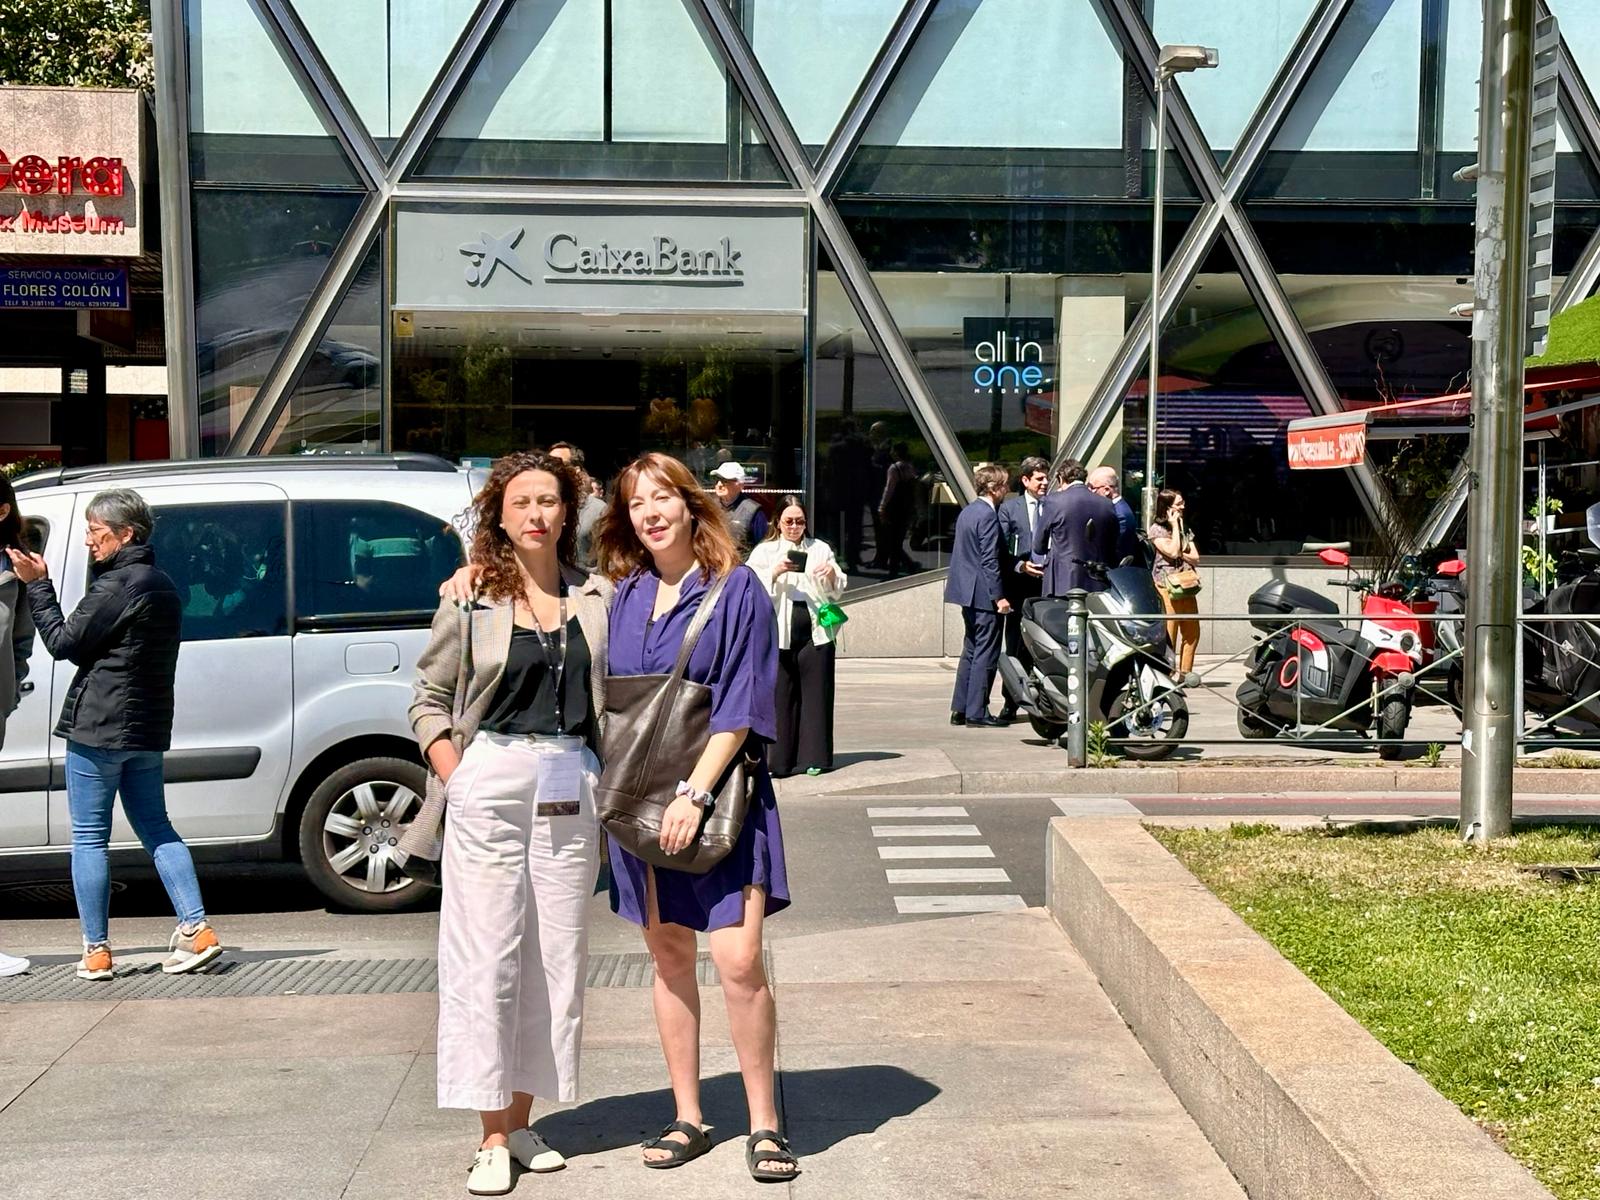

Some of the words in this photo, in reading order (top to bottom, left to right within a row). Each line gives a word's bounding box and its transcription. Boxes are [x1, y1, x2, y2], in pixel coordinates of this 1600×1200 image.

[0, 148, 123, 196] era
[21, 210, 124, 235] Museum
[543, 231, 744, 275] CaixaBank
[8, 270, 52, 280] SERVICIO
[54, 271, 62, 280] A
[63, 271, 115, 281] DOMICILIO
[3, 284, 57, 297] FLORES
[62, 282, 111, 298] COLÓN
[974, 330, 1006, 363] all
[1015, 336, 1043, 363] in
[974, 365, 1043, 387] one
